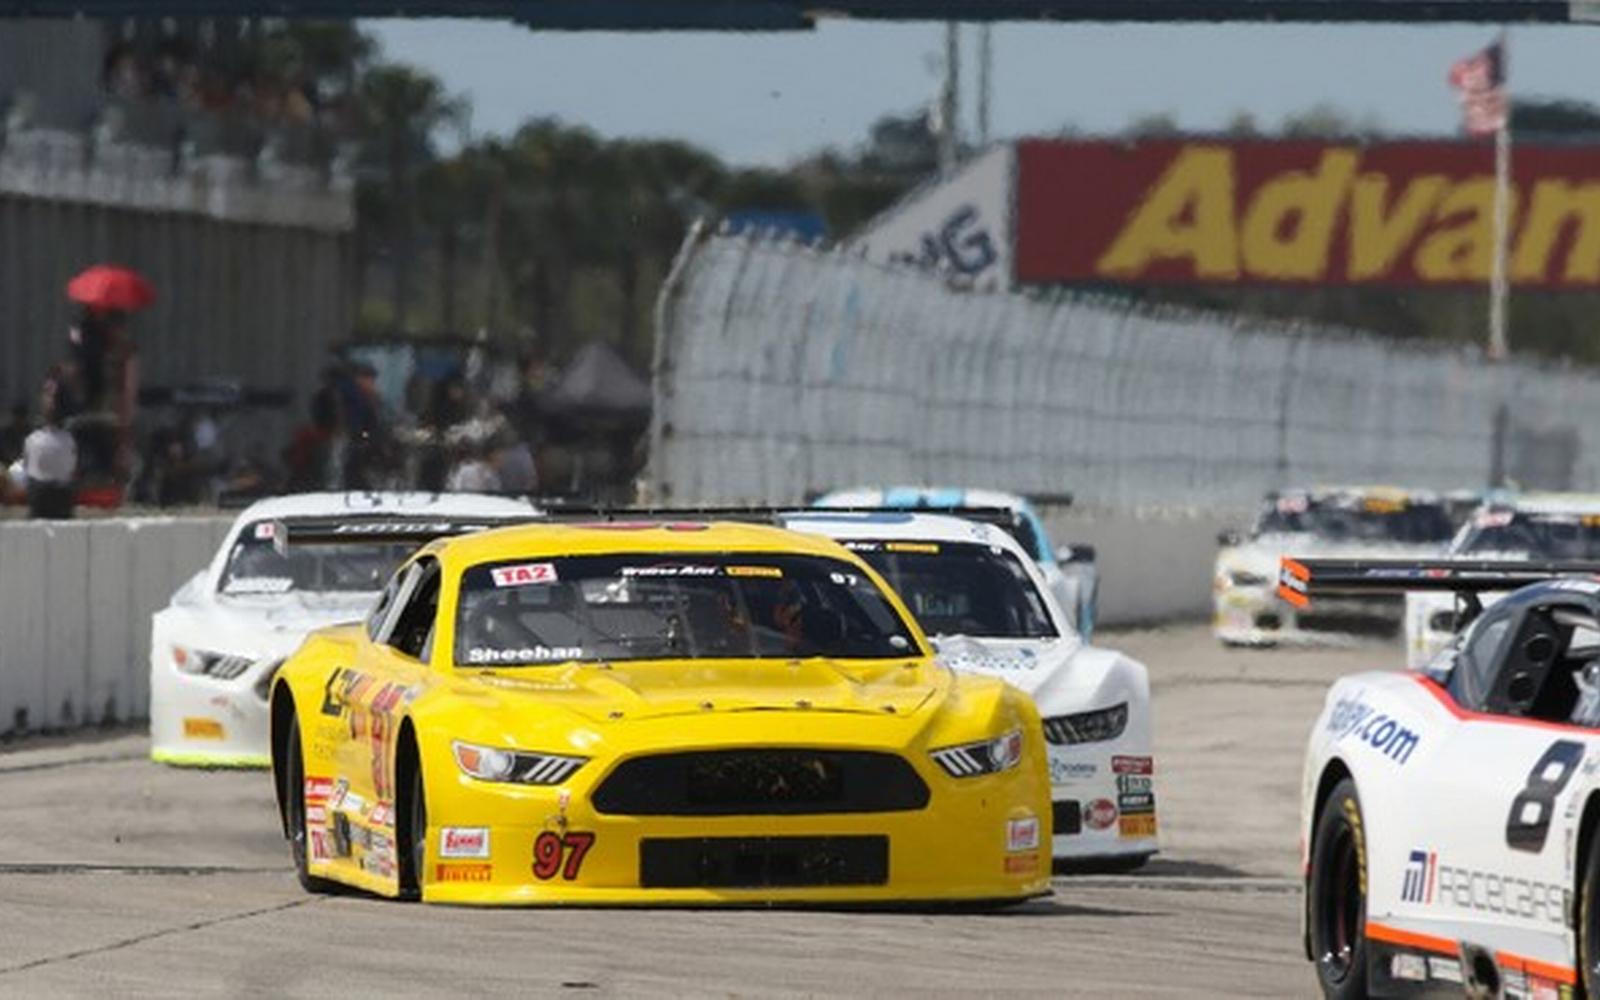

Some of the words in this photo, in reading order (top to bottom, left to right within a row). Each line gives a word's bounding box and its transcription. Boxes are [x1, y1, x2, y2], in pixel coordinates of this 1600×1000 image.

[501, 567, 549, 588] TA2
[829, 572, 858, 586] 97
[468, 645, 583, 663] Sheehan
[1505, 738, 1586, 854] 8
[532, 831, 596, 881] 97
